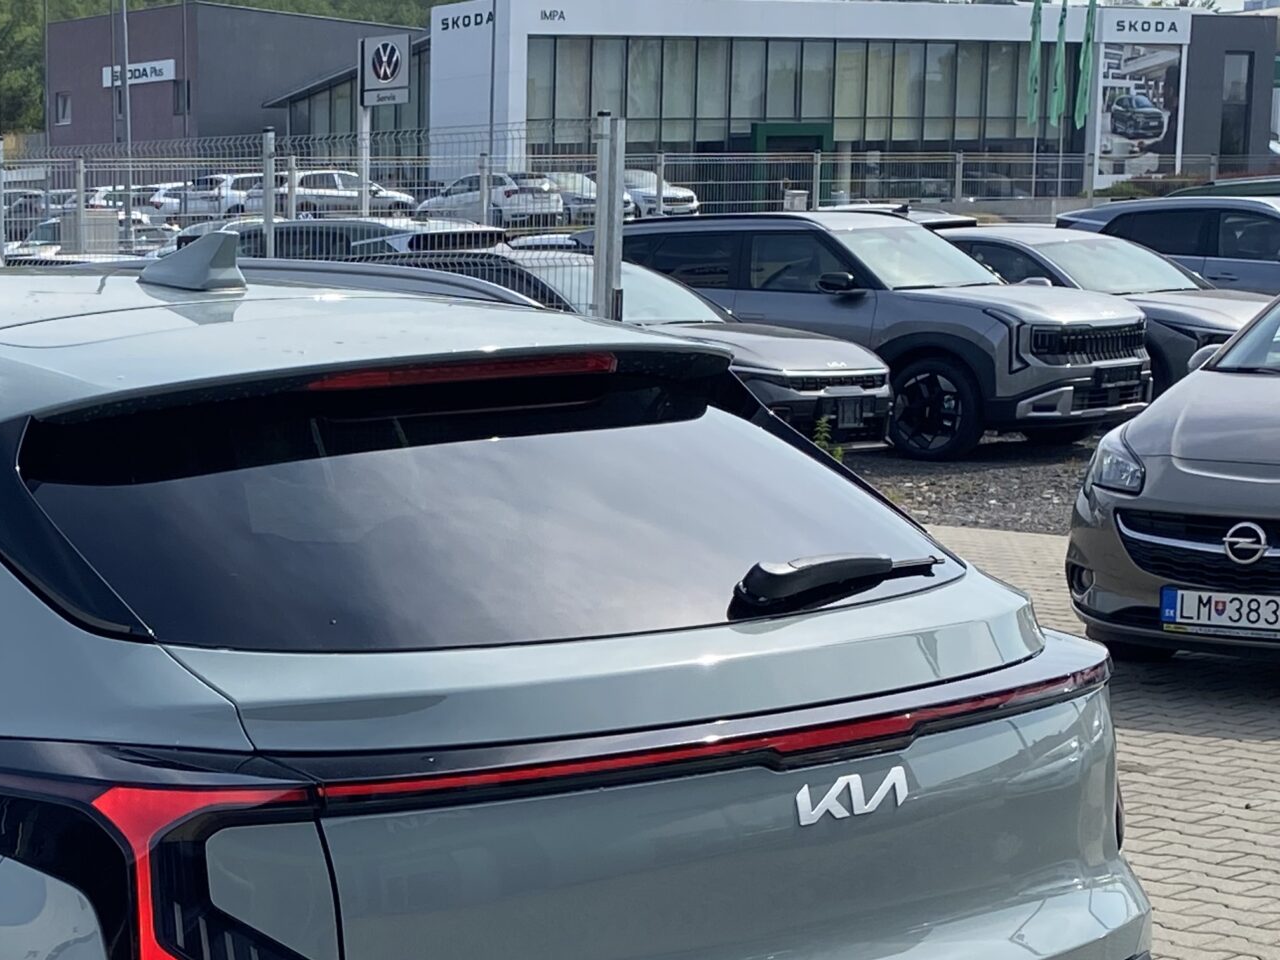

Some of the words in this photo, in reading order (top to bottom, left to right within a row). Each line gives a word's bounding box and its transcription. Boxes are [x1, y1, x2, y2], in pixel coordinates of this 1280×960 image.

[540, 10, 566, 21] IMPA
[1180, 593, 1212, 621] LM
[796, 766, 909, 826] KIA
